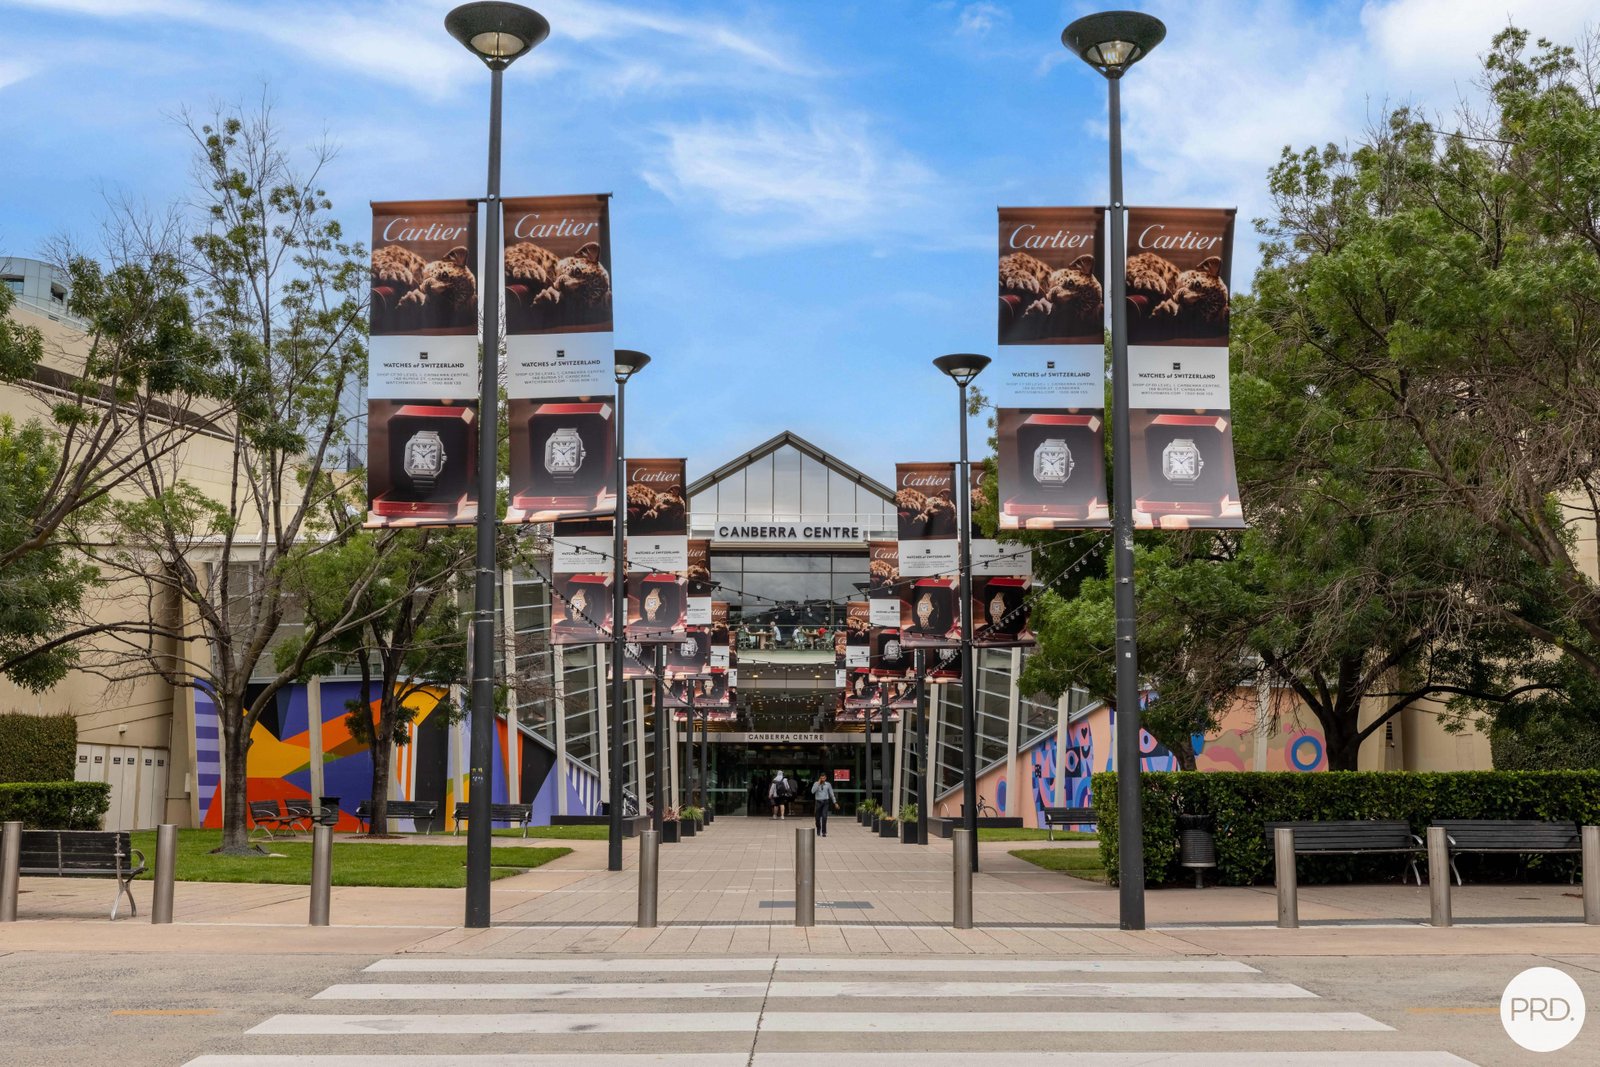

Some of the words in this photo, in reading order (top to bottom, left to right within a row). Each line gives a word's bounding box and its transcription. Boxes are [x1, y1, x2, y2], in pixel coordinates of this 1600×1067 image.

[383, 217, 467, 242] Cartier
[514, 213, 598, 239] Cartier
[1009, 223, 1094, 249] Cartier
[1138, 223, 1223, 249] Cartier
[558, 359, 601, 367] SWITZERLAND
[632, 467, 681, 483] Cartier
[902, 471, 951, 487] Cartier
[719, 526, 797, 538] CANBERRA
[803, 526, 859, 539] CENTRE
